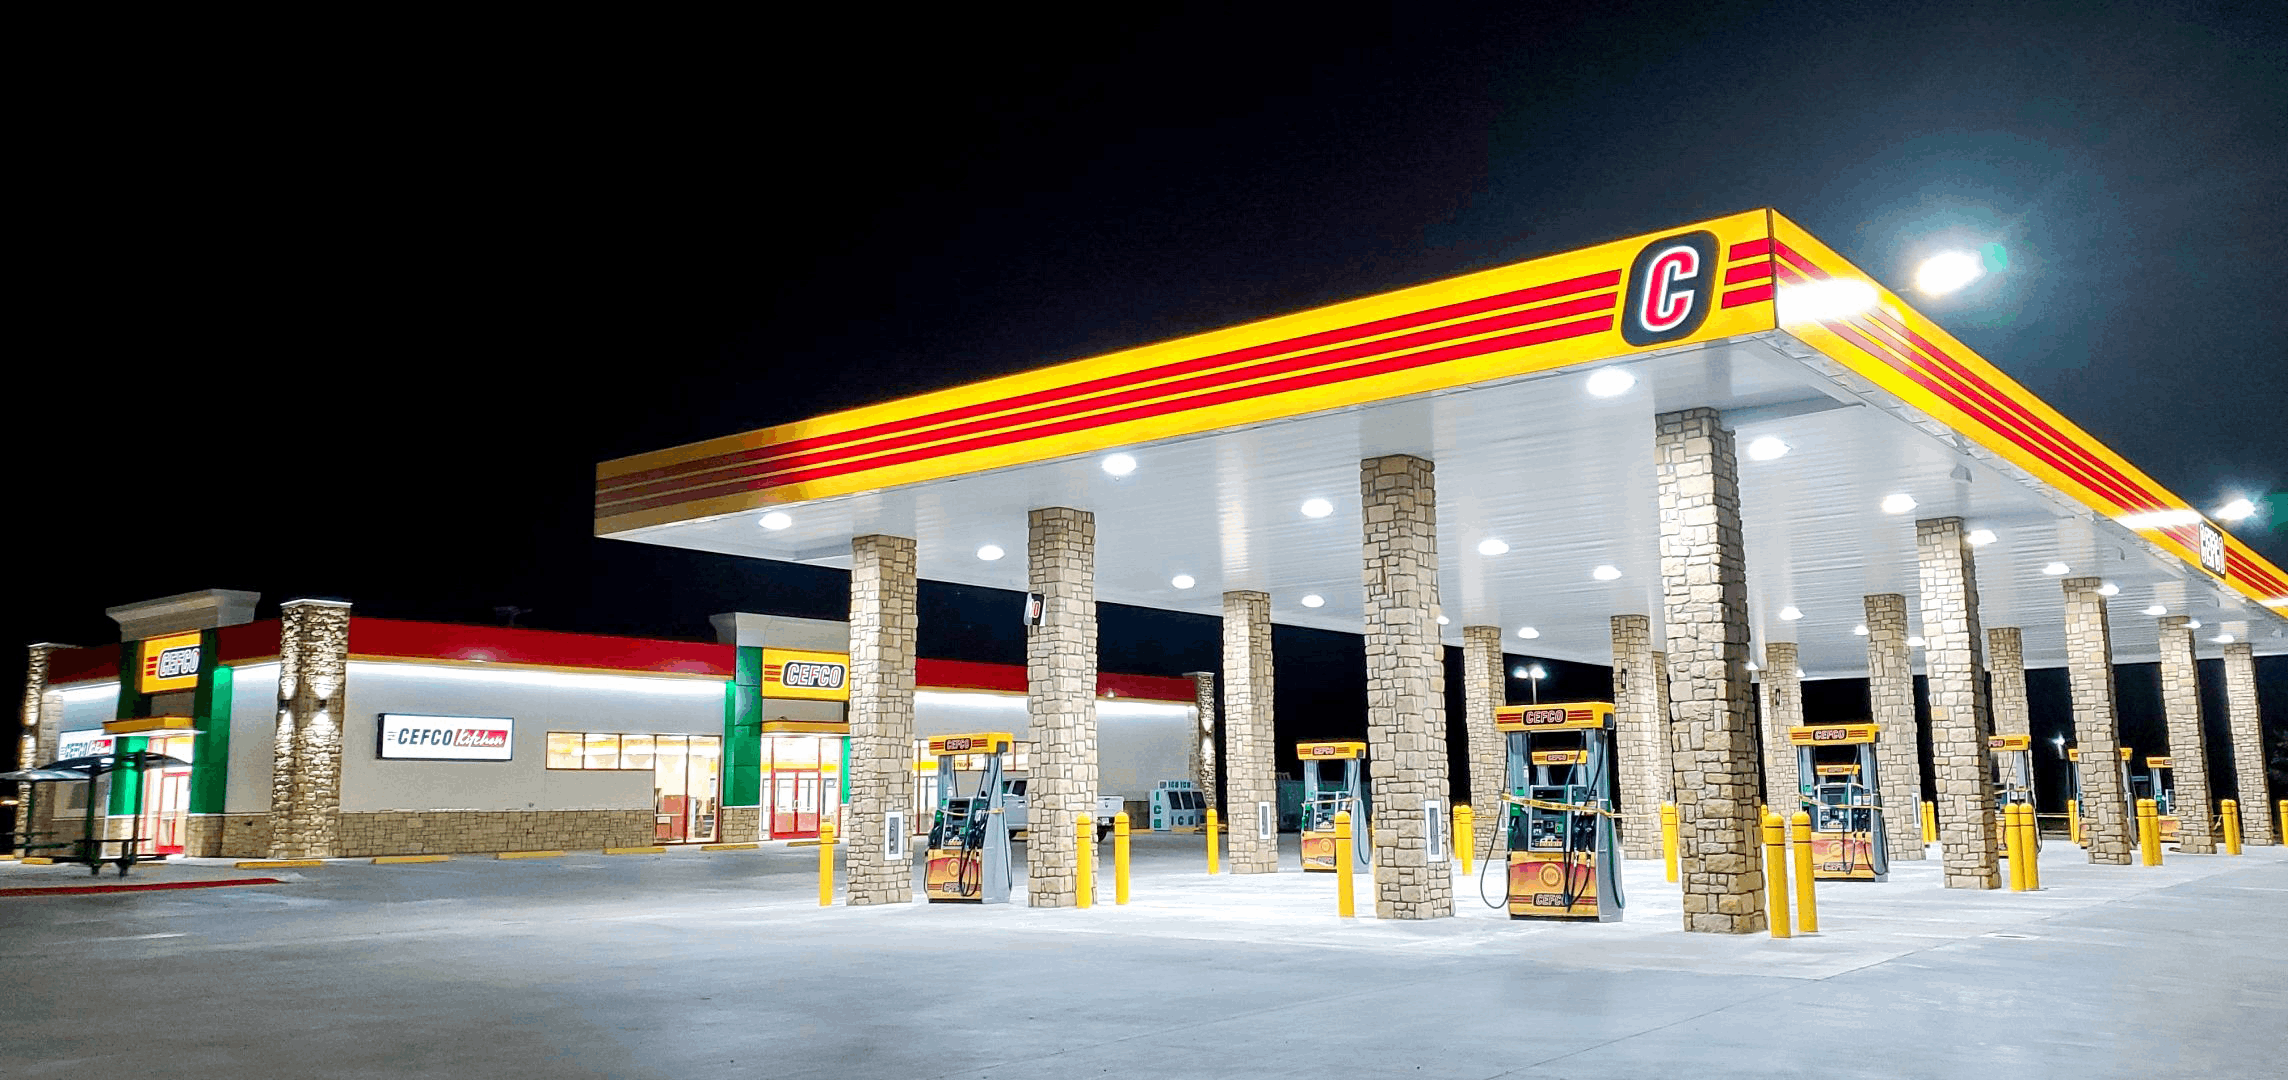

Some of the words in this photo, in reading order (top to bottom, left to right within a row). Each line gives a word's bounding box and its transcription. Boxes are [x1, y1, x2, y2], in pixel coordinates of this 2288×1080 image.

[1641, 246, 1699, 332] C
[159, 648, 200, 676] CEFCO
[786, 663, 842, 687] CEFCO
[1526, 709, 1564, 724] CEFCO
[398, 728, 453, 746] CEFCO
[455, 729, 507, 747] Kitchen
[1815, 729, 1846, 740] CEFCO
[947, 739, 970, 750] CEFCO
[1535, 894, 1564, 906] CEFC
